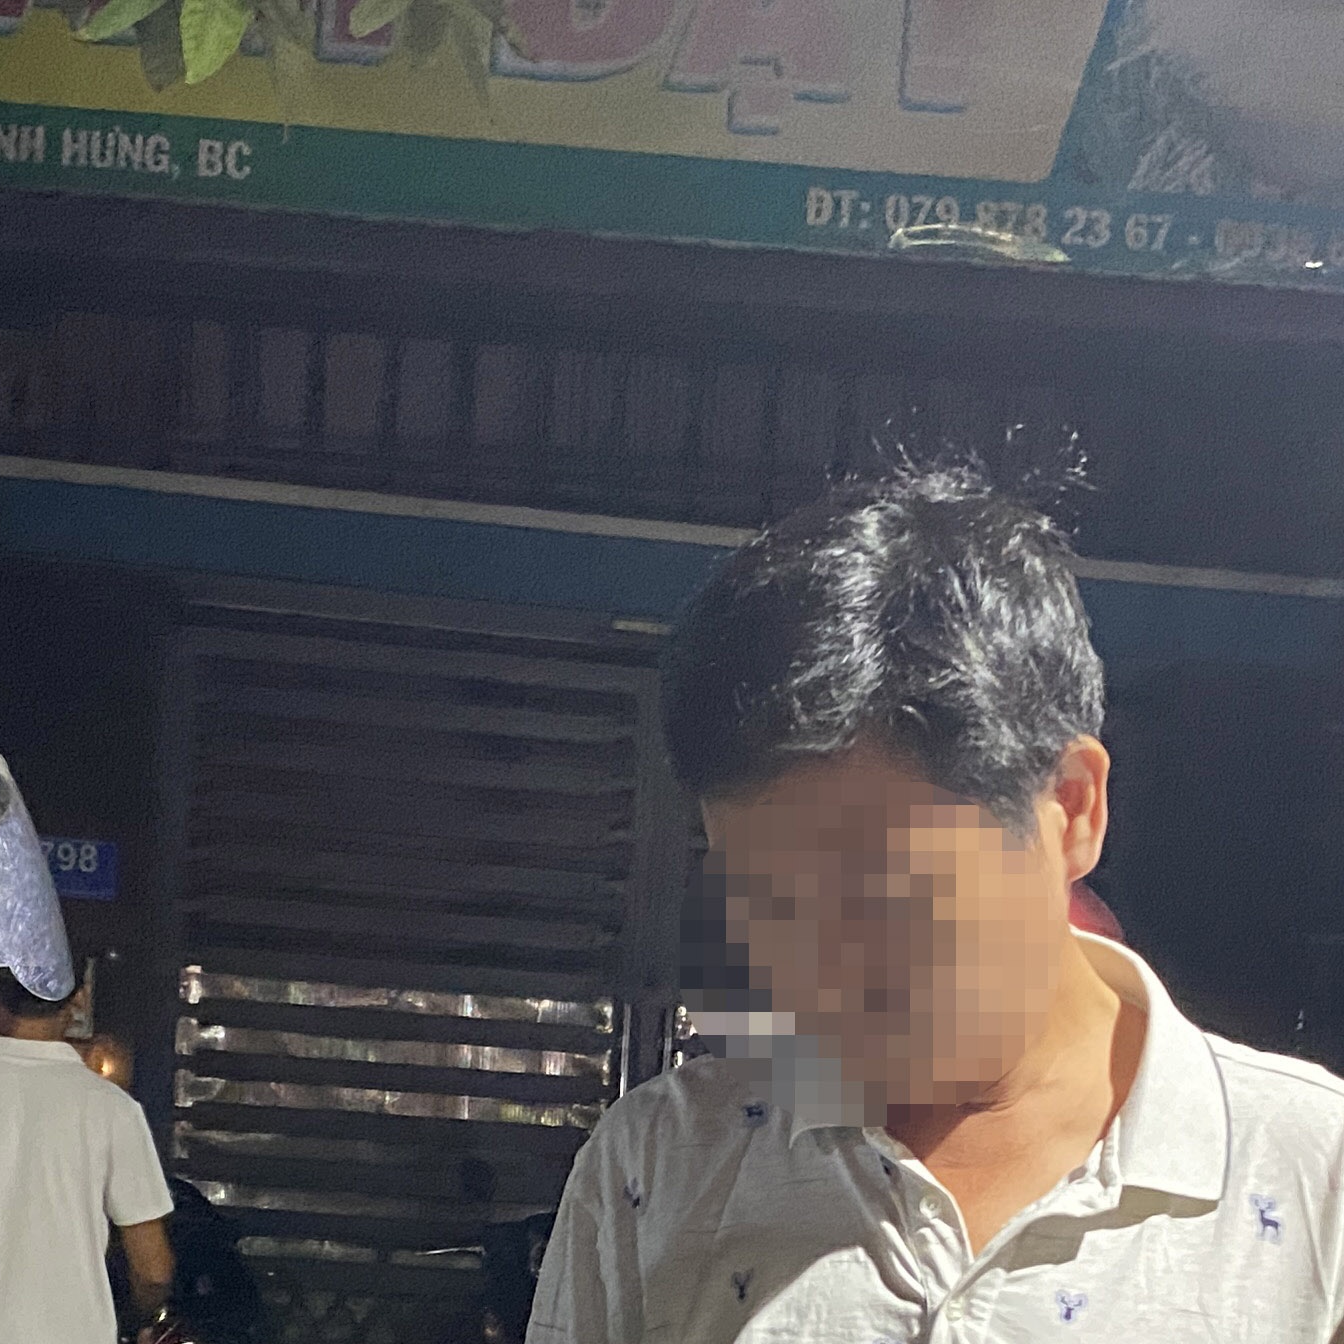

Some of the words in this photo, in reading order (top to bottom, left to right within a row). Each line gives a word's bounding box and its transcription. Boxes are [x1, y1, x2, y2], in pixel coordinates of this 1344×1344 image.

[197, 138, 253, 180] BC
[1060, 206, 1113, 249] 23
[1125, 212, 1172, 252] 67
